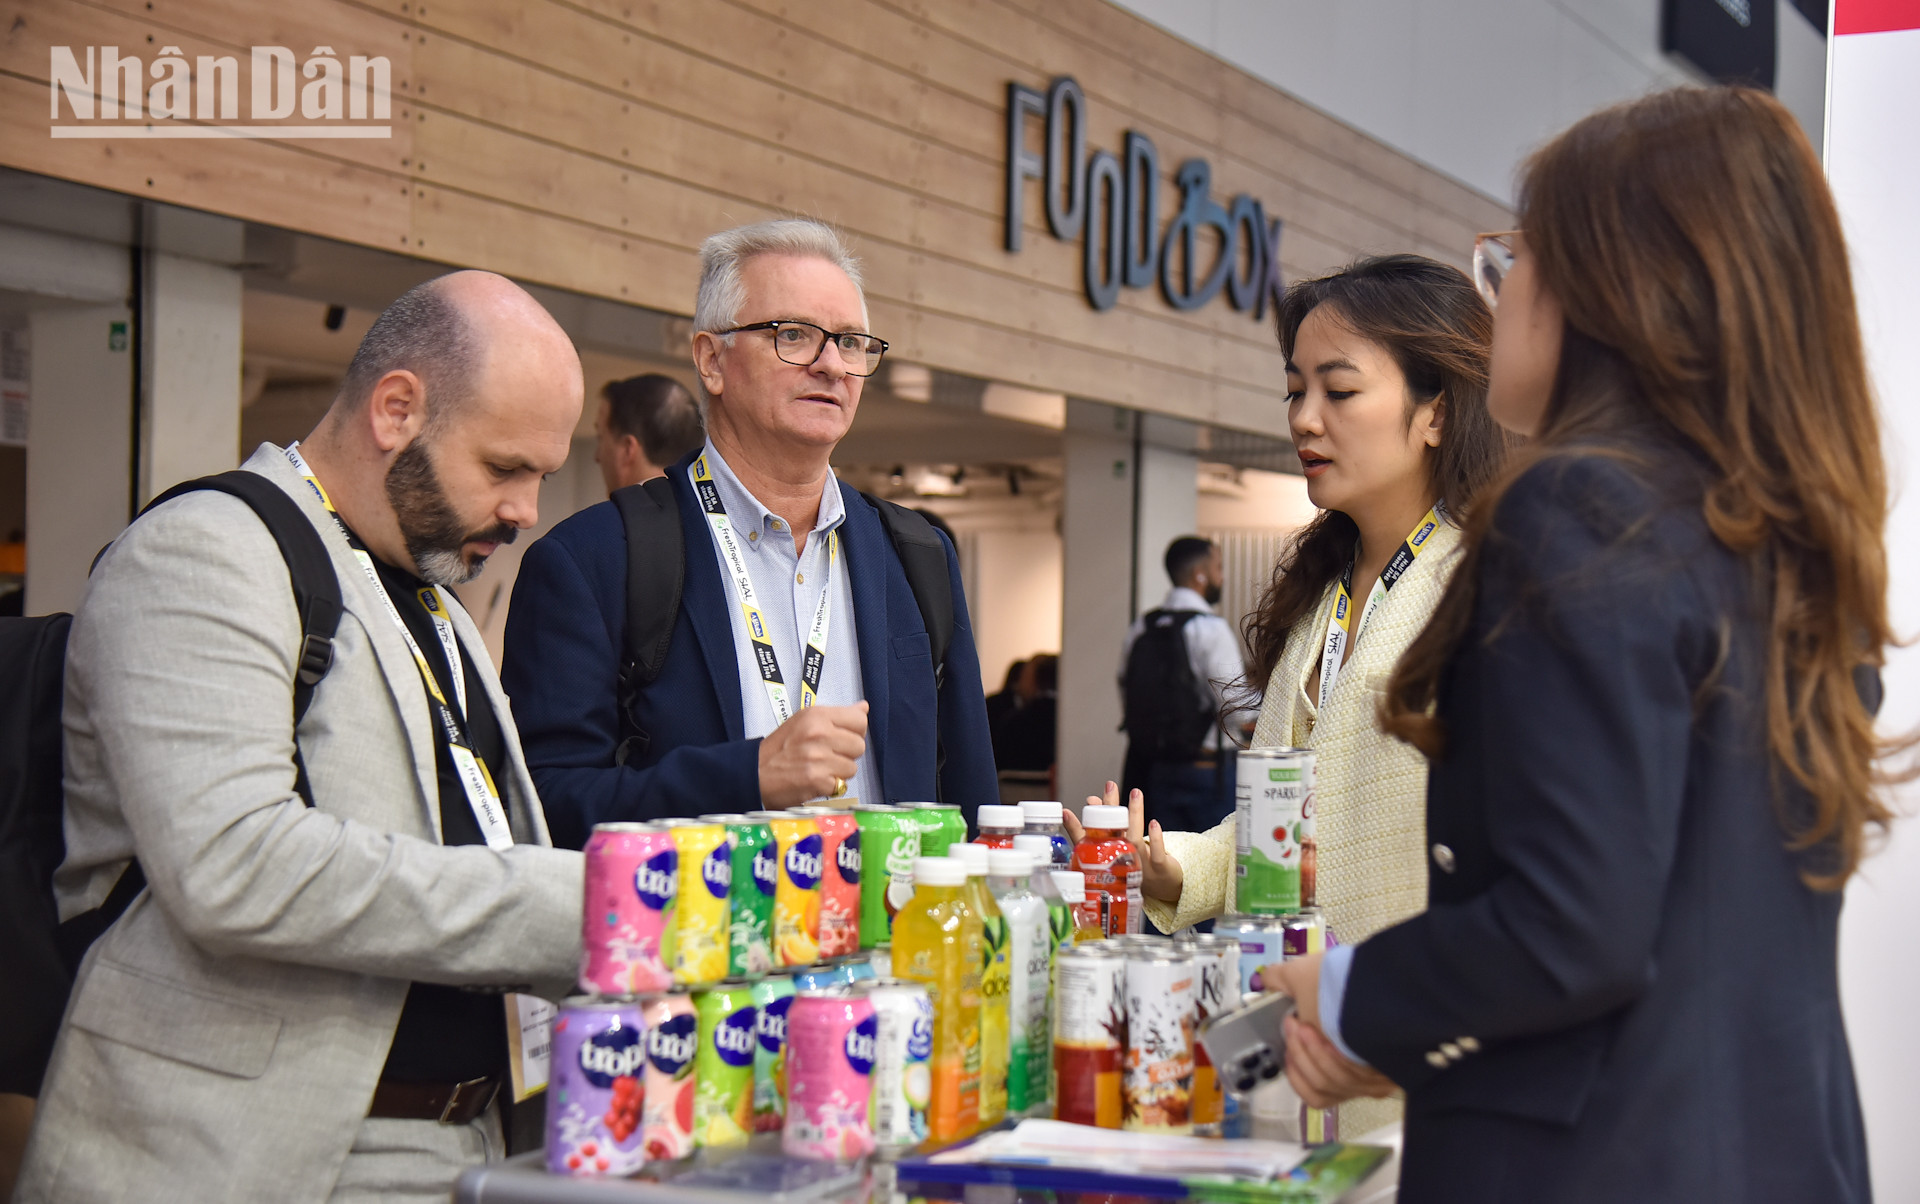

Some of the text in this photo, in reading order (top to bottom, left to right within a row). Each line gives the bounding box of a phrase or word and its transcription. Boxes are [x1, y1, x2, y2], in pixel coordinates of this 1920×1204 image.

[722, 528, 744, 574] FreshTropical
[1392, 551, 1406, 567] stand
[1398, 558, 1409, 573] Hall
[1328, 631, 1341, 654] SIAL
[758, 648, 767, 665] stand
[764, 651, 774, 664] Hall
[806, 665, 814, 678] Hall
[810, 668, 819, 684] stand
[468, 767, 499, 827] FreshTropical
